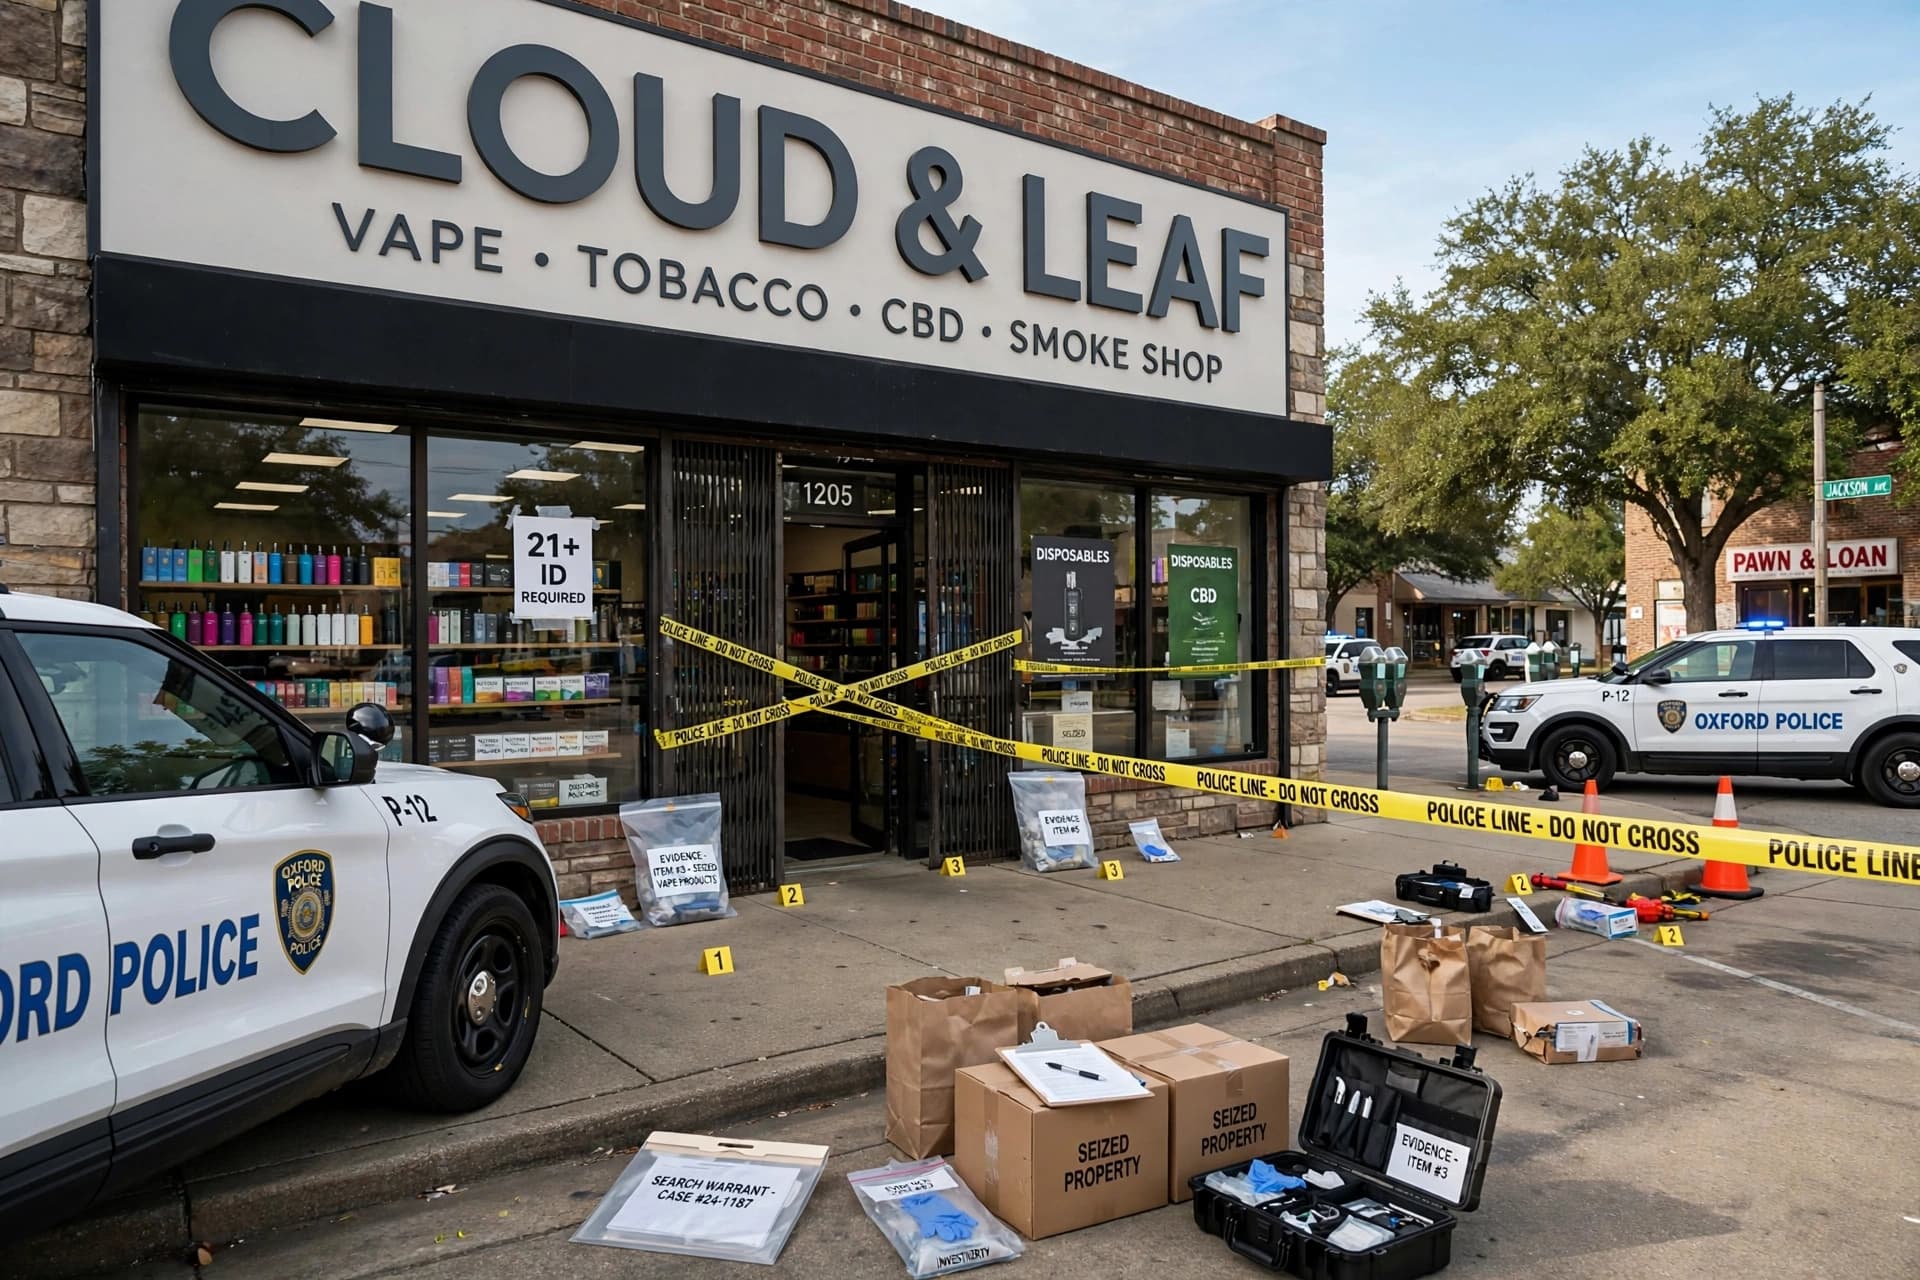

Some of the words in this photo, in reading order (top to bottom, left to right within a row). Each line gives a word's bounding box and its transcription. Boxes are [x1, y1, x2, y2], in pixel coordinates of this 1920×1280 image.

[169, 0, 858, 249] CLOUD
[895, 146, 989, 283] &
[1022, 174, 1269, 333] LEAF
[332, 202, 502, 273] VAPE
[578, 245, 828, 321] TOBACCO
[882, 298, 963, 343] CBD
[1010, 320, 1129, 370] SMOKE
[1143, 343, 1223, 383] SHOP
[803, 482, 853, 506] 1205
[1827, 481, 1868, 498] JACKSON
[527, 532, 580, 557] 21+
[1036, 547, 1110, 563] DISPOSABLES
[1171, 554, 1233, 570] DISPOSABLES
[1734, 550, 1791, 573] PAWN
[1800, 548, 1815, 570] &
[1827, 545, 1887, 569] LOAN
[541, 564, 567, 585] ID
[521, 591, 586, 604] REQUIRED
[1190, 587, 1217, 604] CBD
[660, 620, 688, 639] POLICE
[690, 629, 708, 648] LINE
[715, 641, 728, 653] DO
[729, 645, 746, 660] NOT
[747, 653, 775, 671] CROSS
[1602, 690, 1630, 702] P-12
[675, 730, 704, 744] POLICE
[708, 722, 724, 736] LINE
[733, 718, 744, 730] DO
[746, 714, 762, 728] NOT
[765, 704, 790, 722] CROSS
[1695, 713, 1769, 730] OXFORD
[1776, 713, 1843, 730] POLICE
[1042, 748, 1070, 765] POLICE
[1072, 752, 1090, 769] LINE
[1097, 757, 1109, 772] DO
[1111, 759, 1129, 776] NOT
[1133, 763, 1165, 782] CROSS
[1197, 771, 1237, 793] POLICE
[1240, 777, 1268, 797] LINE
[1279, 783, 1296, 800] DO
[1300, 787, 1327, 806] NOT
[1331, 789, 1379, 814] CROSS
[381, 794, 438, 827] P-12
[1045, 815, 1080, 825] EVIDENCE
[1053, 825, 1069, 835] ITEM
[1427, 800, 1486, 829] POLICE
[1491, 807, 1532, 834] LINE
[1549, 815, 1575, 840] DO
[1582, 818, 1622, 846] NOT
[1627, 824, 1700, 855] CROSS
[660, 851, 703, 864] EVIDENCE
[1769, 838, 1858, 873] POLICE
[281, 859, 326, 879] OXFORD
[653, 866, 674, 877] ITEM
[952, 859, 961, 873] 3
[1109, 863, 1118, 877] 3
[287, 872, 322, 893] POLICE
[656, 877, 678, 889] VAPE
[1517, 876, 1527, 891] 2
[788, 887, 797, 903] 2
[290, 935, 321, 955] POLICE
[1668, 927, 1677, 943] 2
[110, 913, 259, 1016] POLICE
[714, 951, 723, 970] 1
[1213, 1103, 1257, 1129] SEIZED
[1078, 1134, 1129, 1163] SEIZED
[1201, 1123, 1267, 1156] PROPERTY
[1402, 1134, 1453, 1162] EVIDENCE
[1064, 1155, 1141, 1192] PROPERTY
[1408, 1155, 1432, 1173] ITEM
[1434, 1166, 1448, 1179] #3
[652, 1176, 703, 1190] SEARCH
[706, 1180, 770, 1196] WARRANT
[657, 1190, 694, 1203] CASE
[695, 1194, 754, 1208] #24-1187
